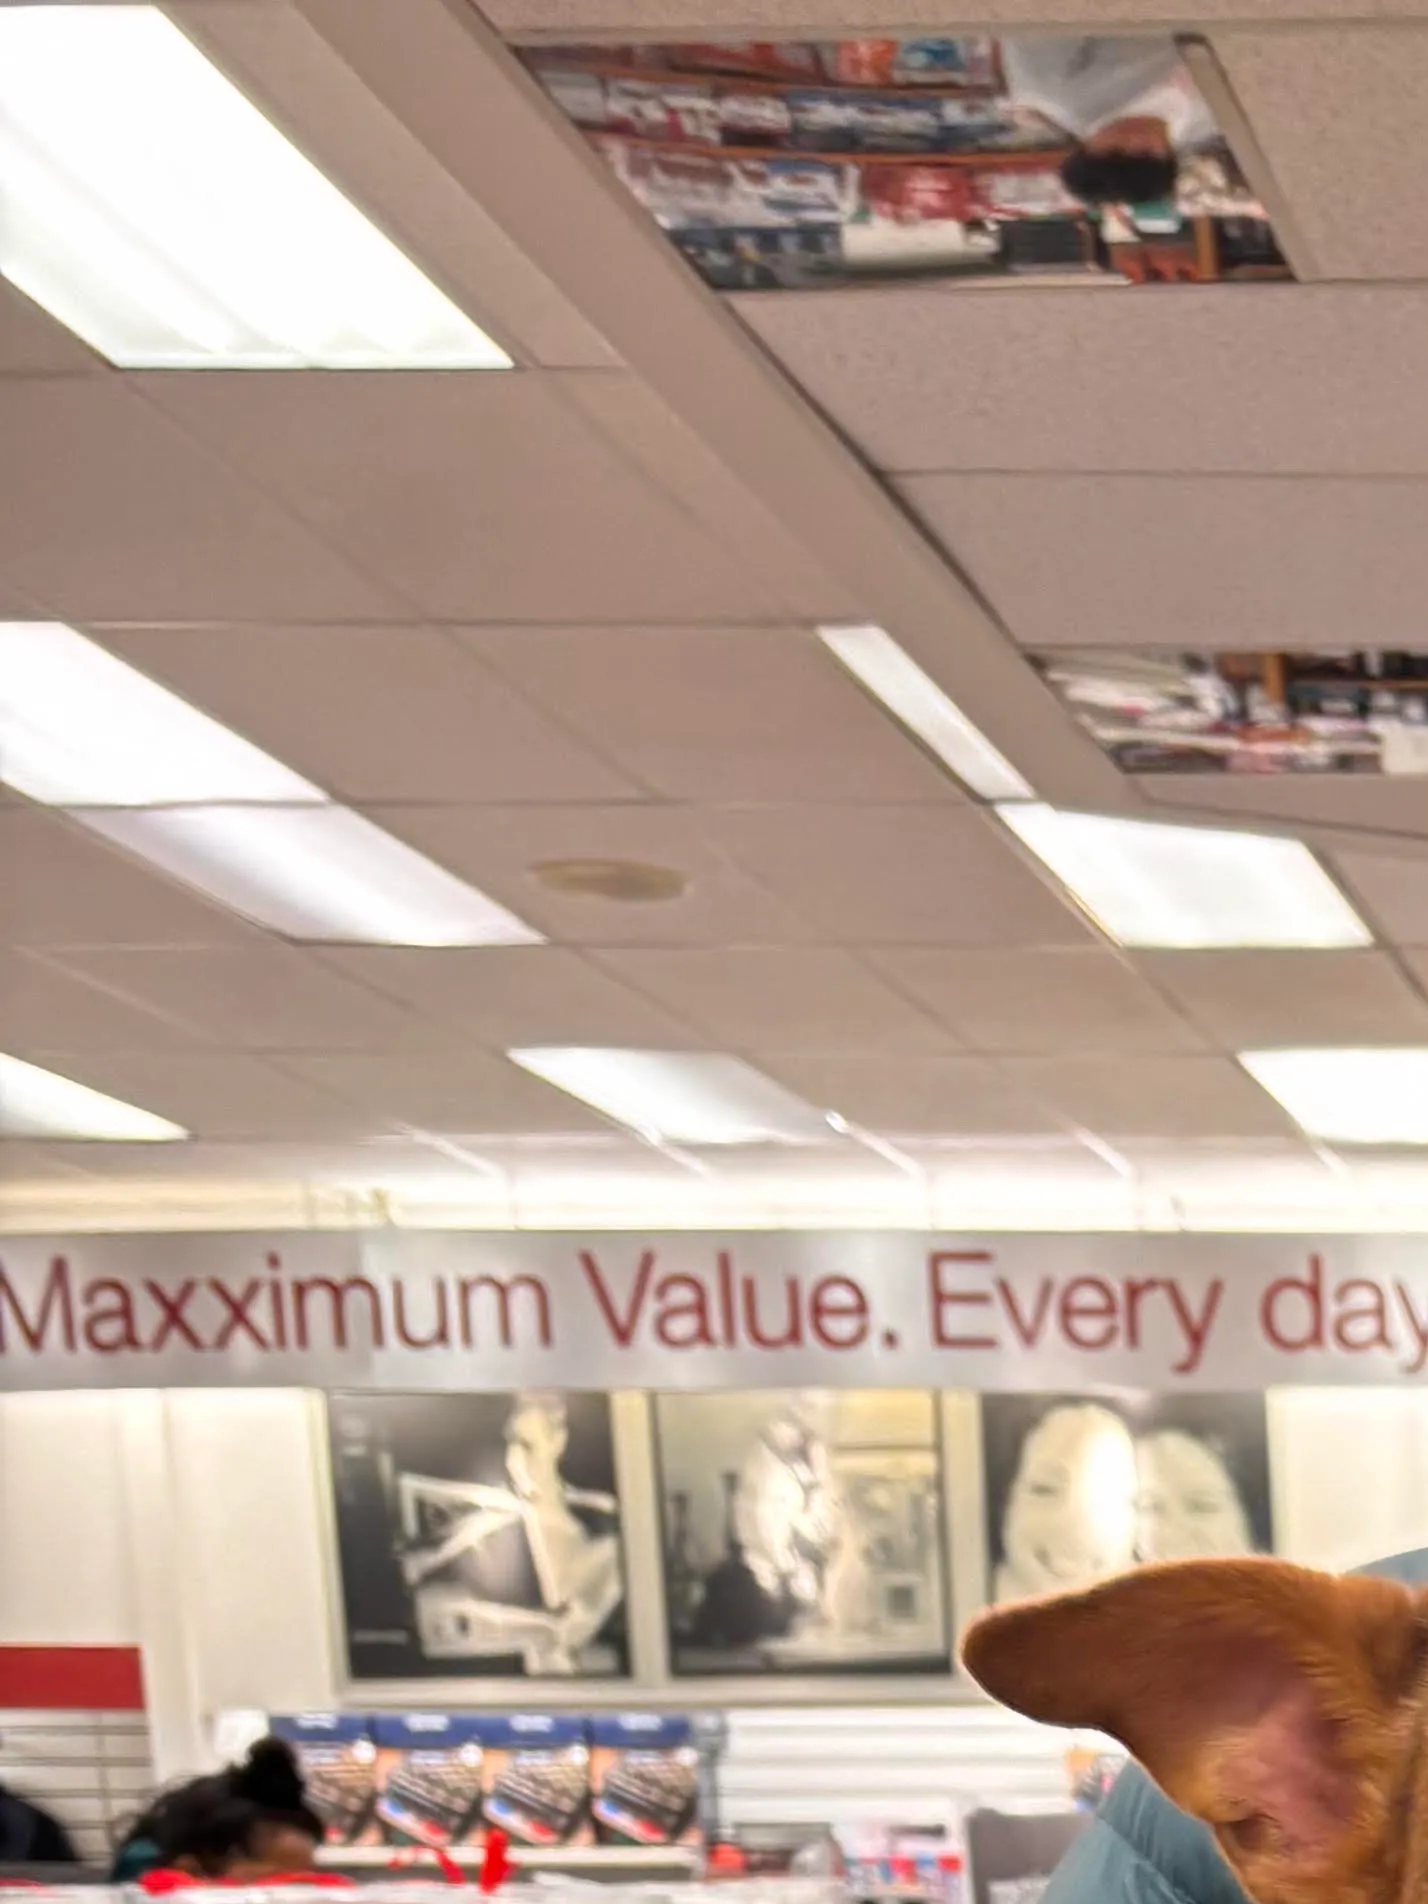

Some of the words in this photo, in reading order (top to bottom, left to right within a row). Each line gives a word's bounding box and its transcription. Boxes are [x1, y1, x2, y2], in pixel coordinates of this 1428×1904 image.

[0, 1253, 551, 1352] Maxximum
[577, 1249, 897, 1349] Value.
[926, 1250, 1224, 1374] Every
